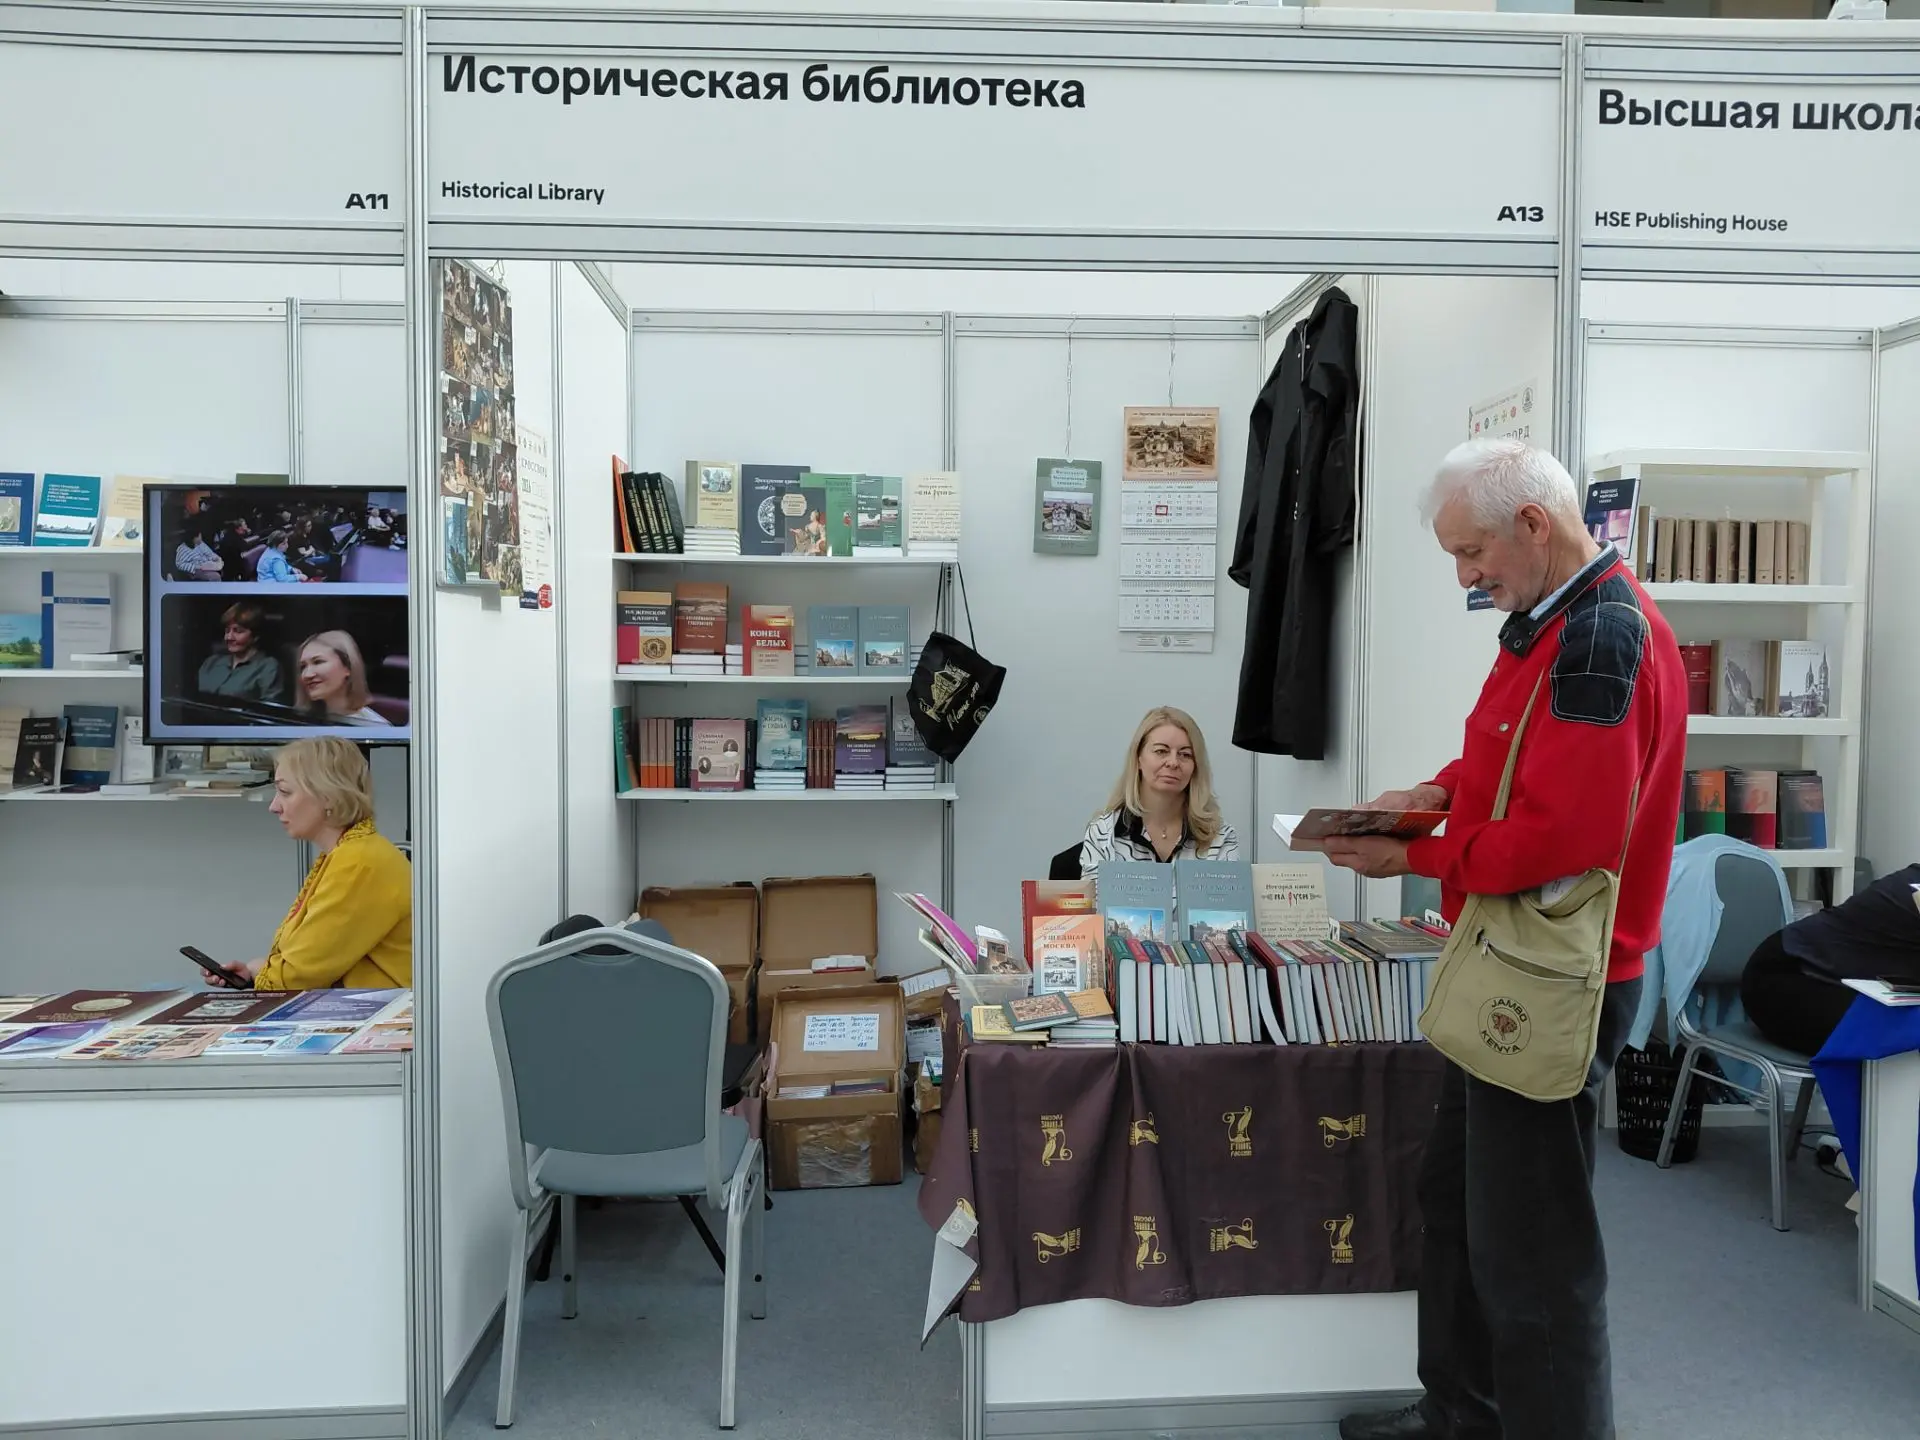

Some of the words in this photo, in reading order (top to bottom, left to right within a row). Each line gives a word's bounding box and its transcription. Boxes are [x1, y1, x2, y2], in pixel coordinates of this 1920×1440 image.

[442, 55, 789, 104] Историческая
[802, 64, 1086, 108] библиотека
[1598, 88, 1779, 129] Высшая
[1792, 102, 1920, 131] школ
[344, 193, 389, 210] A11
[442, 180, 533, 200] Historical
[538, 182, 605, 206] Library
[1496, 205, 1544, 223] A13
[1595, 211, 1631, 228] HSE
[1635, 211, 1728, 234] Publishing
[1732, 214, 1788, 232] House
[750, 630, 781, 638] КОНЕЦ
[756, 639, 787, 647] БЕЛЫХ
[1491, 998, 1528, 1023] JAMBO
[1481, 1030, 1521, 1053] KENYA
